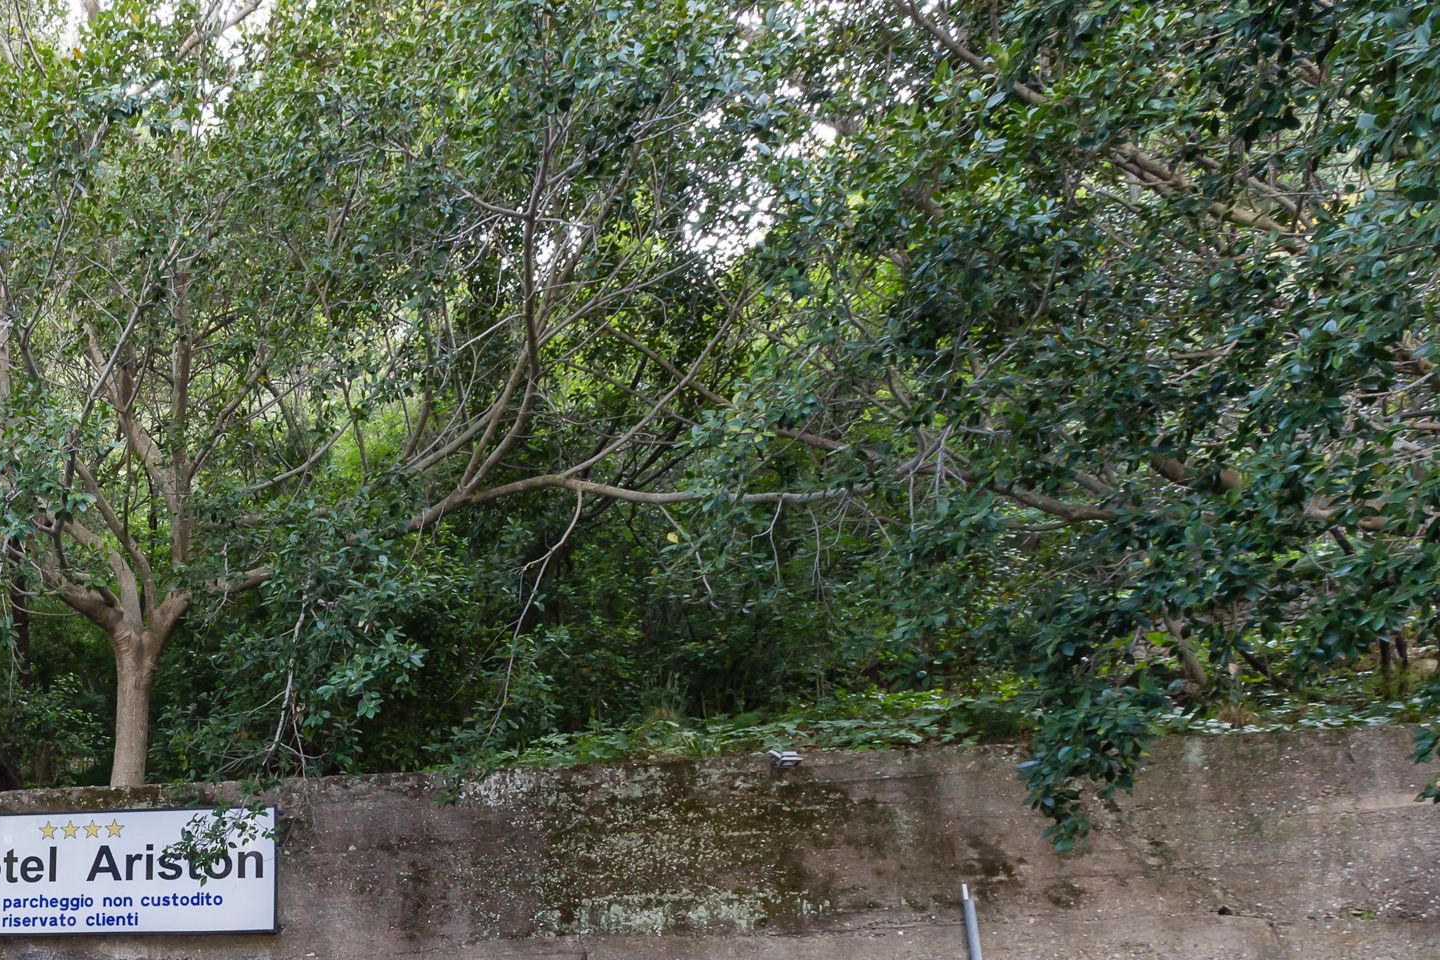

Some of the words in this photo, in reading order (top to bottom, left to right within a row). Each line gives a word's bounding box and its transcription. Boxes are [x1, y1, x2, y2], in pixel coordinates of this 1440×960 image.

[86, 844, 265, 883] Ariston
[2, 894, 94, 911] parcheggio
[102, 896, 133, 907] non
[140, 892, 223, 907] custodito
[2, 914, 77, 927] riservato
[85, 912, 139, 927] clienti
